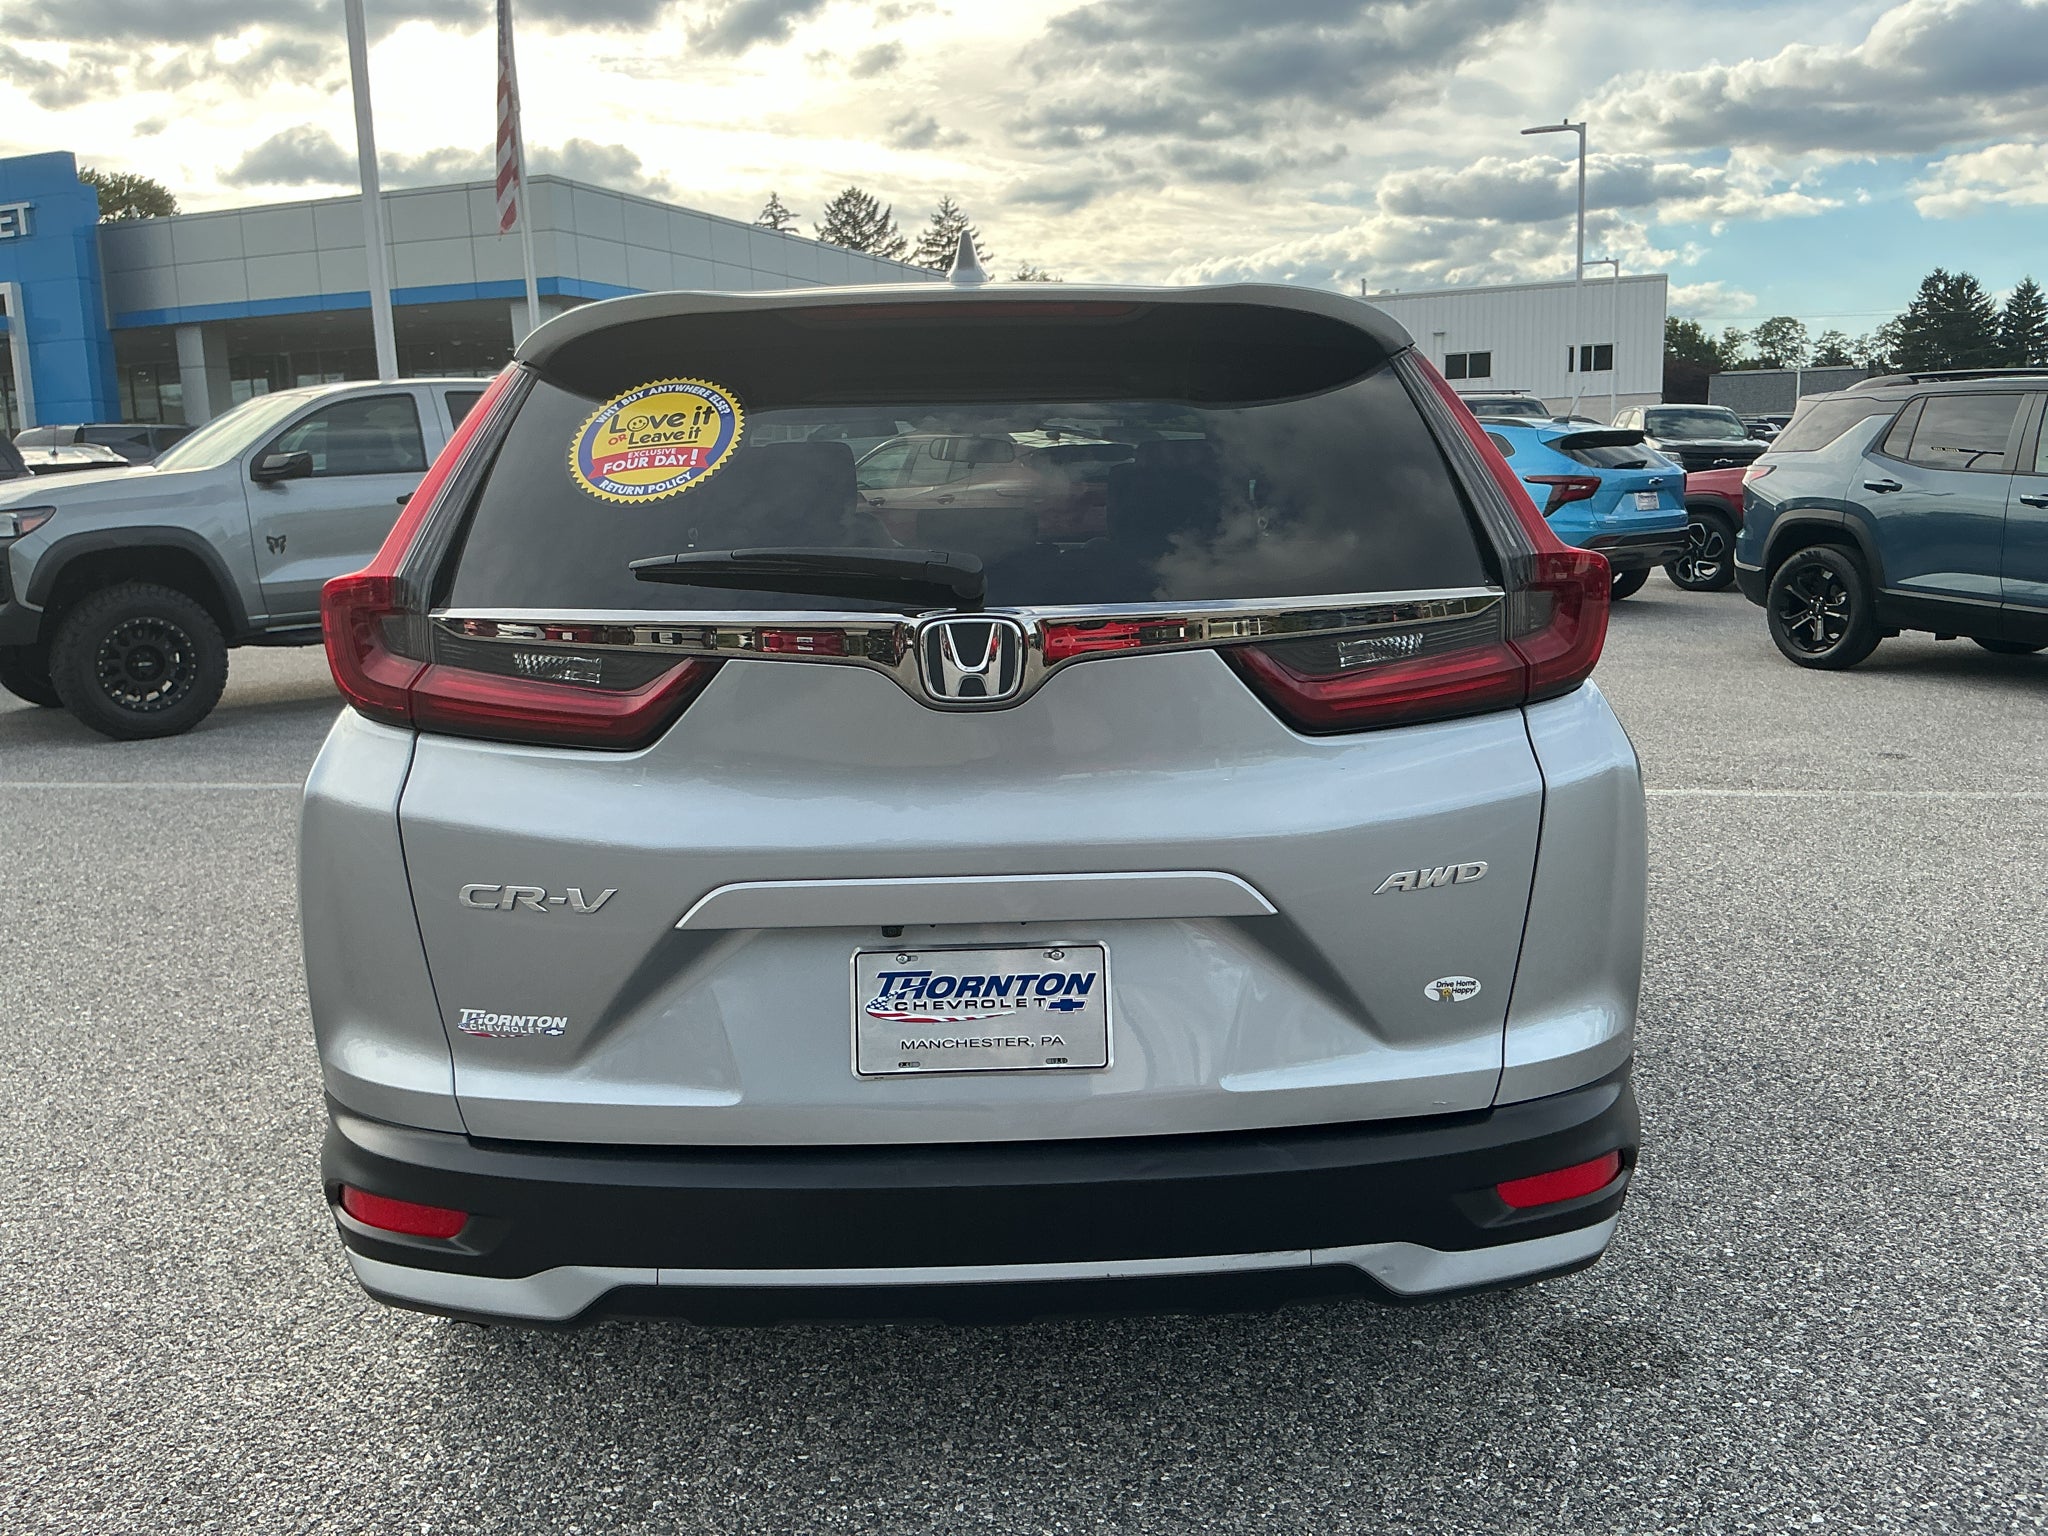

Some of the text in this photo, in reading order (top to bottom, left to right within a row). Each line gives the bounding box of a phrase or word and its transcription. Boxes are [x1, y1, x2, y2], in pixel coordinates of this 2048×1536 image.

[596, 384, 731, 424] WHY BUY ANYWHERE ELSE?
[608, 406, 715, 434] Love it
[608, 426, 701, 446] OR Leave it
[627, 448, 677, 458] EXCLUSIVE
[602, 456, 649, 474] FOUR
[600, 471, 692, 495] RETURN POLICY
[1372, 861, 1488, 895] AWD
[458, 883, 618, 914] CR-V
[876, 970, 1096, 1000] THORNTON
[894, 997, 1047, 1011] CHEVROLET
[459, 1008, 568, 1029] THORNTON
[470, 1022, 543, 1034] CHEVROLET
[901, 1036, 1065, 1050] MANCHESTER, PA
